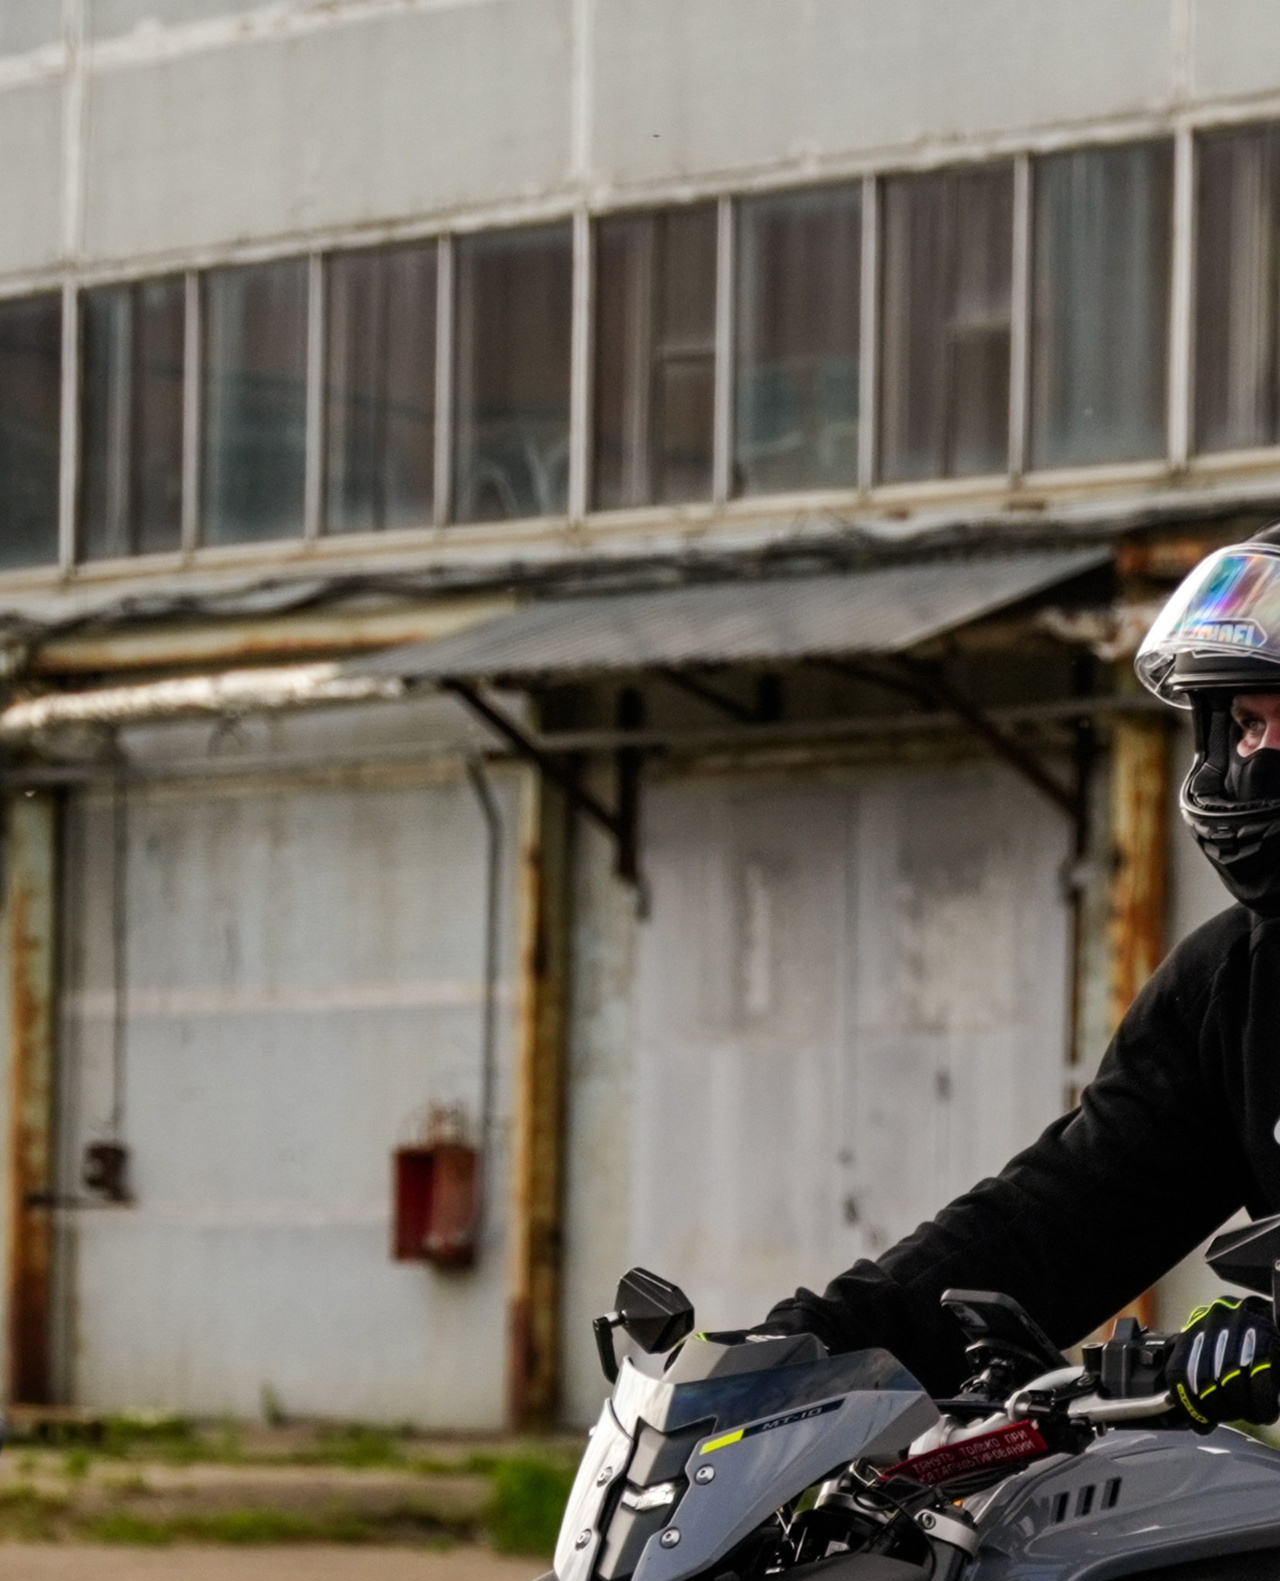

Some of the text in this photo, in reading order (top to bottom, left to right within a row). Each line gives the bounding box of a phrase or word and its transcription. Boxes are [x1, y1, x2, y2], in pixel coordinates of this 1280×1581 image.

[762, 1407, 823, 1430] MT-10
[912, 1429, 1028, 1474] ТЯНУТЬ ТОЛЬКО ПРИ
